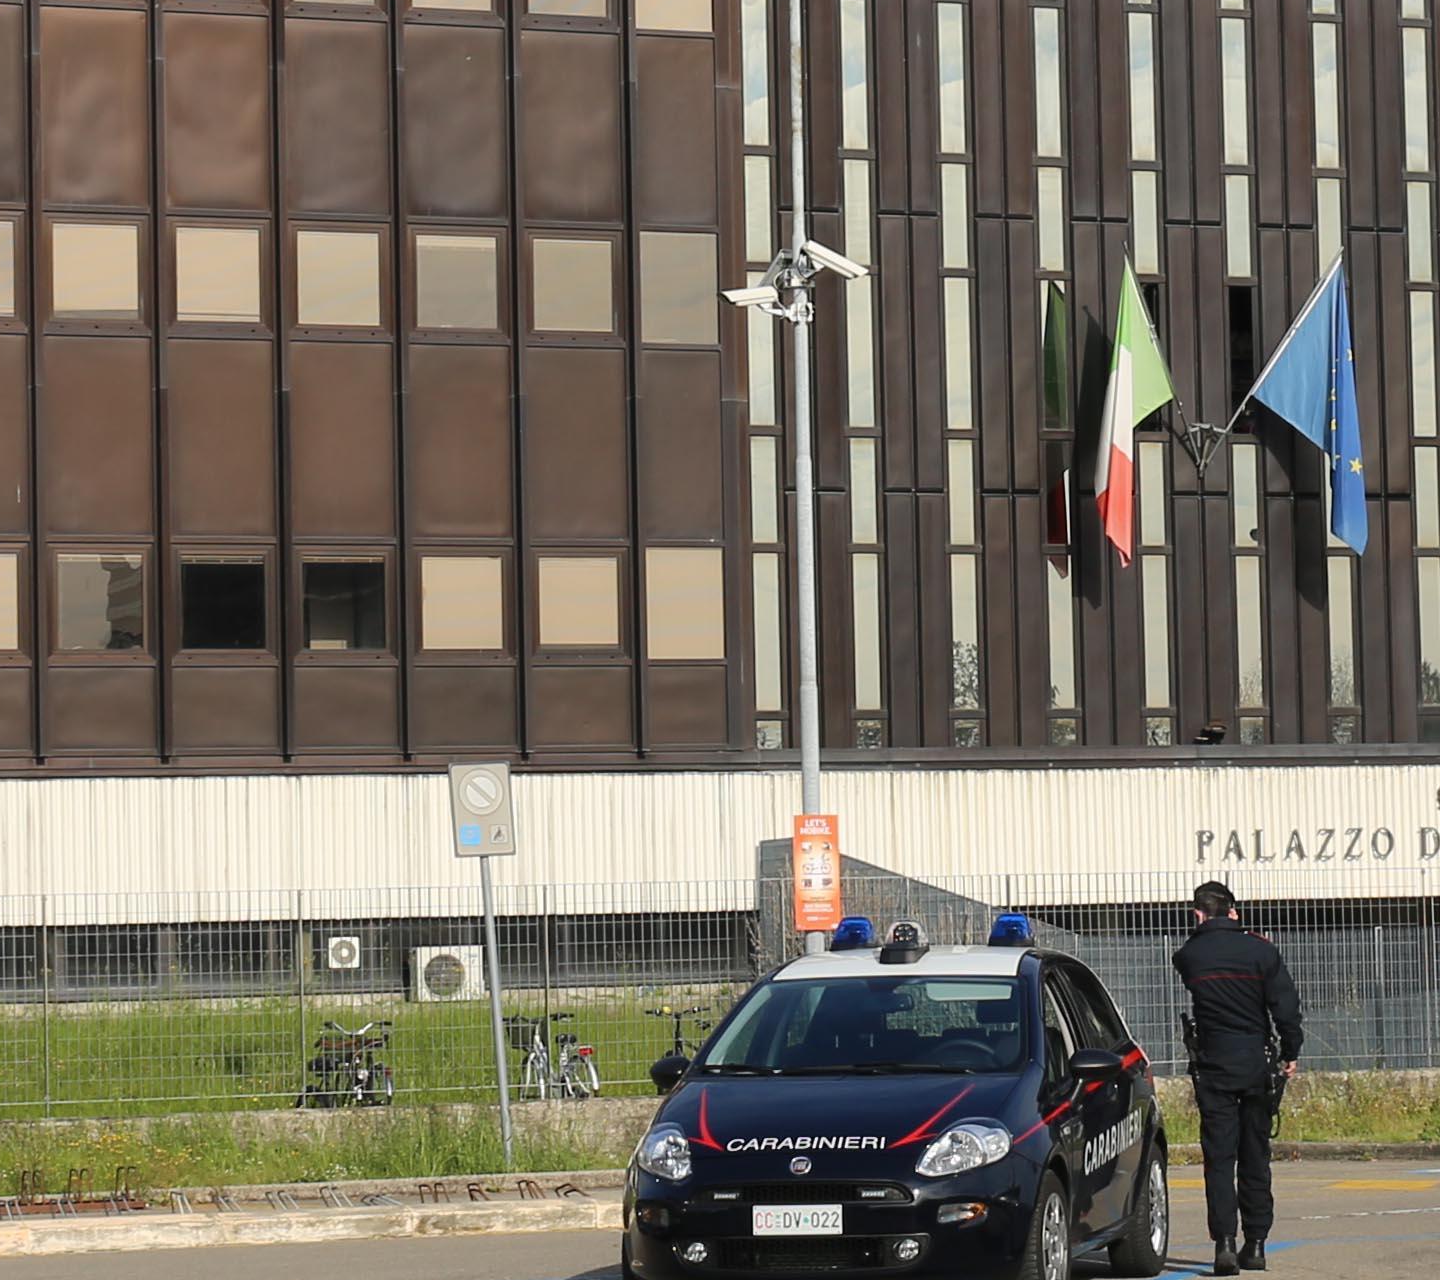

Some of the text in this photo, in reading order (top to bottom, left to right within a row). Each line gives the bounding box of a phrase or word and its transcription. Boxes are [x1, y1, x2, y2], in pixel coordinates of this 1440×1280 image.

[1195, 826, 1395, 864] PALAZZO
[726, 1136, 886, 1152] CARABINIERI
[1084, 1107, 1142, 1176] CARABINIERI
